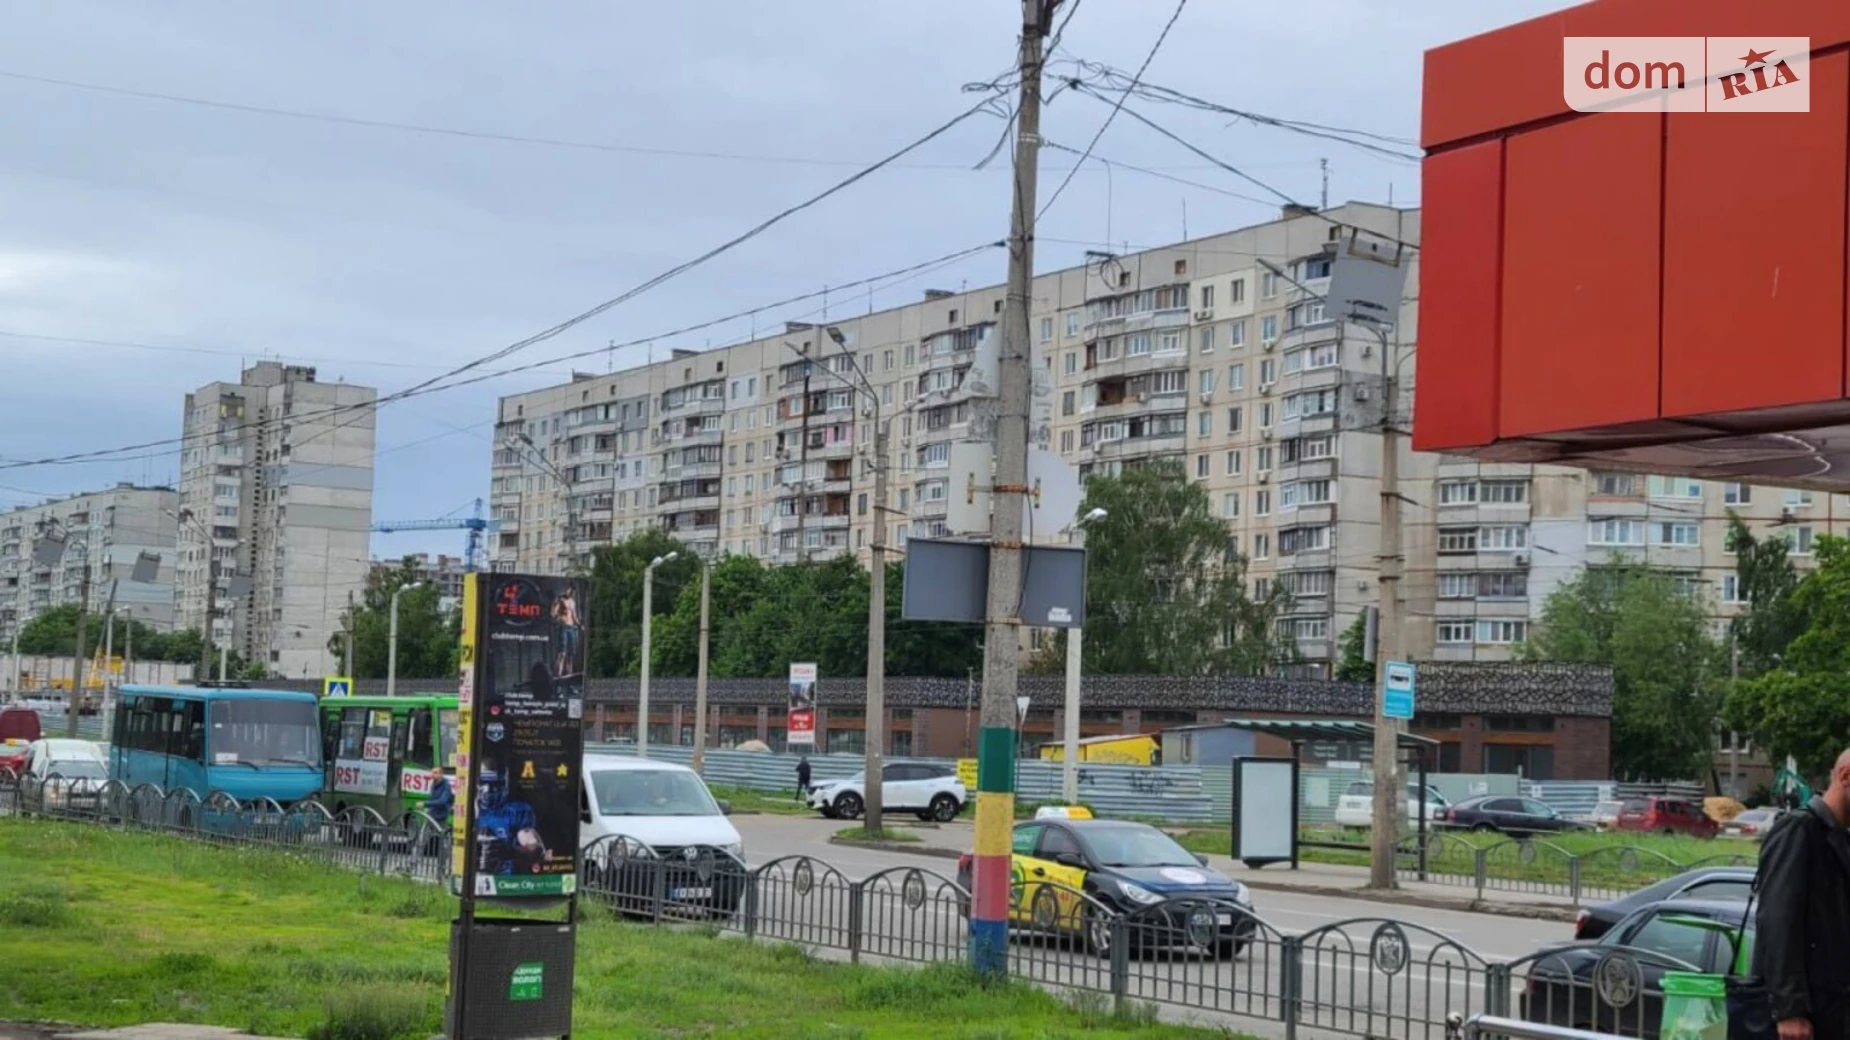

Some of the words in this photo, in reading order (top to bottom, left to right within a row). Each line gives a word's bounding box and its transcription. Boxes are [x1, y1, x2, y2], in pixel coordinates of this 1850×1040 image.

[365, 741, 388, 758] RST
[336, 766, 360, 785] RST
[403, 773, 432, 791] RST
